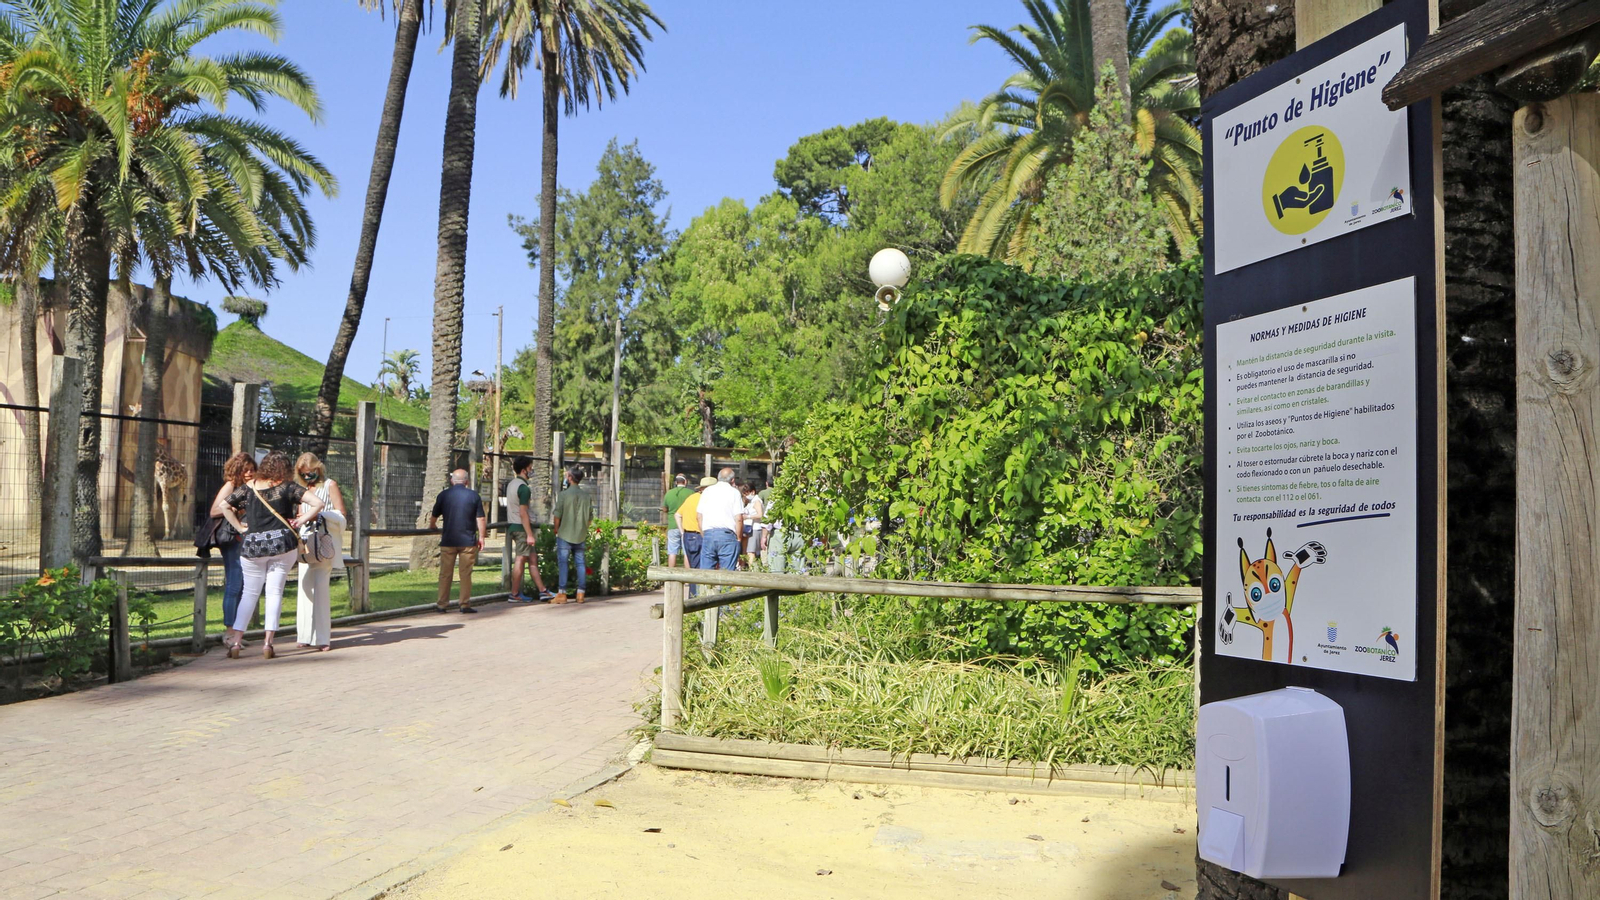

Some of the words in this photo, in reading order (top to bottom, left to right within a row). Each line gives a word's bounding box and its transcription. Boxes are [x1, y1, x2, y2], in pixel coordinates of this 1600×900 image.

[1225, 112, 1278, 146] “Punto
[1284, 98, 1303, 123] de
[1310, 51, 1390, 112] Higiene”
[1250, 327, 1280, 343] NORMAS
[1281, 326, 1287, 336] Y
[1288, 318, 1320, 334] MEDIDAS
[1322, 315, 1332, 326] DE
[1334, 308, 1367, 323] HIGIENE
[1266, 349, 1292, 361] distancia
[1294, 347, 1302, 355] de
[1303, 340, 1336, 354] seguridad
[1337, 336, 1365, 346] durante
[1366, 333, 1372, 341] la
[1374, 329, 1396, 339] visita.
[1237, 382, 1257, 392] puedes
[1258, 376, 1287, 387] mantener
[1297, 370, 1326, 381] distancia
[1327, 368, 1335, 376] de
[1337, 361, 1374, 376] seguridad.
[1243, 368, 1276, 380] obligatorio
[1277, 365, 1283, 373] el
[1284, 364, 1295, 372] uso
[1305, 356, 1338, 368] mascarilla
[1237, 397, 1253, 405] Evitar
[1260, 392, 1286, 401] contacto
[1297, 387, 1315, 396] zonas
[1317, 385, 1325, 393] de
[1326, 379, 1364, 391] barandillas
[1365, 379, 1370, 387] y
[1237, 406, 1263, 416] similares,
[1274, 402, 1290, 411] como
[1301, 397, 1329, 406] cristales.
[1237, 421, 1254, 429] Utiliza
[1288, 413, 1312, 422] "Puntos
[1324, 407, 1352, 419] Higiene"
[1354, 403, 1395, 414] habilitados
[1237, 432, 1247, 440] por
[1255, 427, 1294, 437] Zoobotánico.
[1251, 443, 1272, 452] tocarte
[1284, 441, 1298, 449] ojos,
[1300, 439, 1315, 448] nariz
[1316, 439, 1321, 447] y
[1243, 459, 1258, 467] toser
[1264, 457, 1297, 465] estornudar
[1299, 454, 1324, 462] cúbrete
[1333, 451, 1349, 459] boca
[1356, 449, 1374, 457] nariz
[1375, 449, 1389, 457] con
[1390, 447, 1397, 455] el
[1251, 468, 1283, 477] flexionado
[1313, 464, 1341, 475] pañuelo
[1342, 461, 1384, 471] desechable.
[1243, 484, 1261, 492] tienes
[1299, 481, 1319, 490] fiebre,
[1338, 479, 1354, 487] falta
[1237, 495, 1261, 503] contacta
[1308, 492, 1322, 500] 061.
[1233, 513, 1242, 522] Tu
[1243, 509, 1296, 522] responsabilidad
[1299, 509, 1306, 517] es
[1308, 507, 1315, 515] la
[1318, 503, 1356, 516] seguridad
[1358, 503, 1368, 512] de
[1371, 500, 1396, 511] todos
